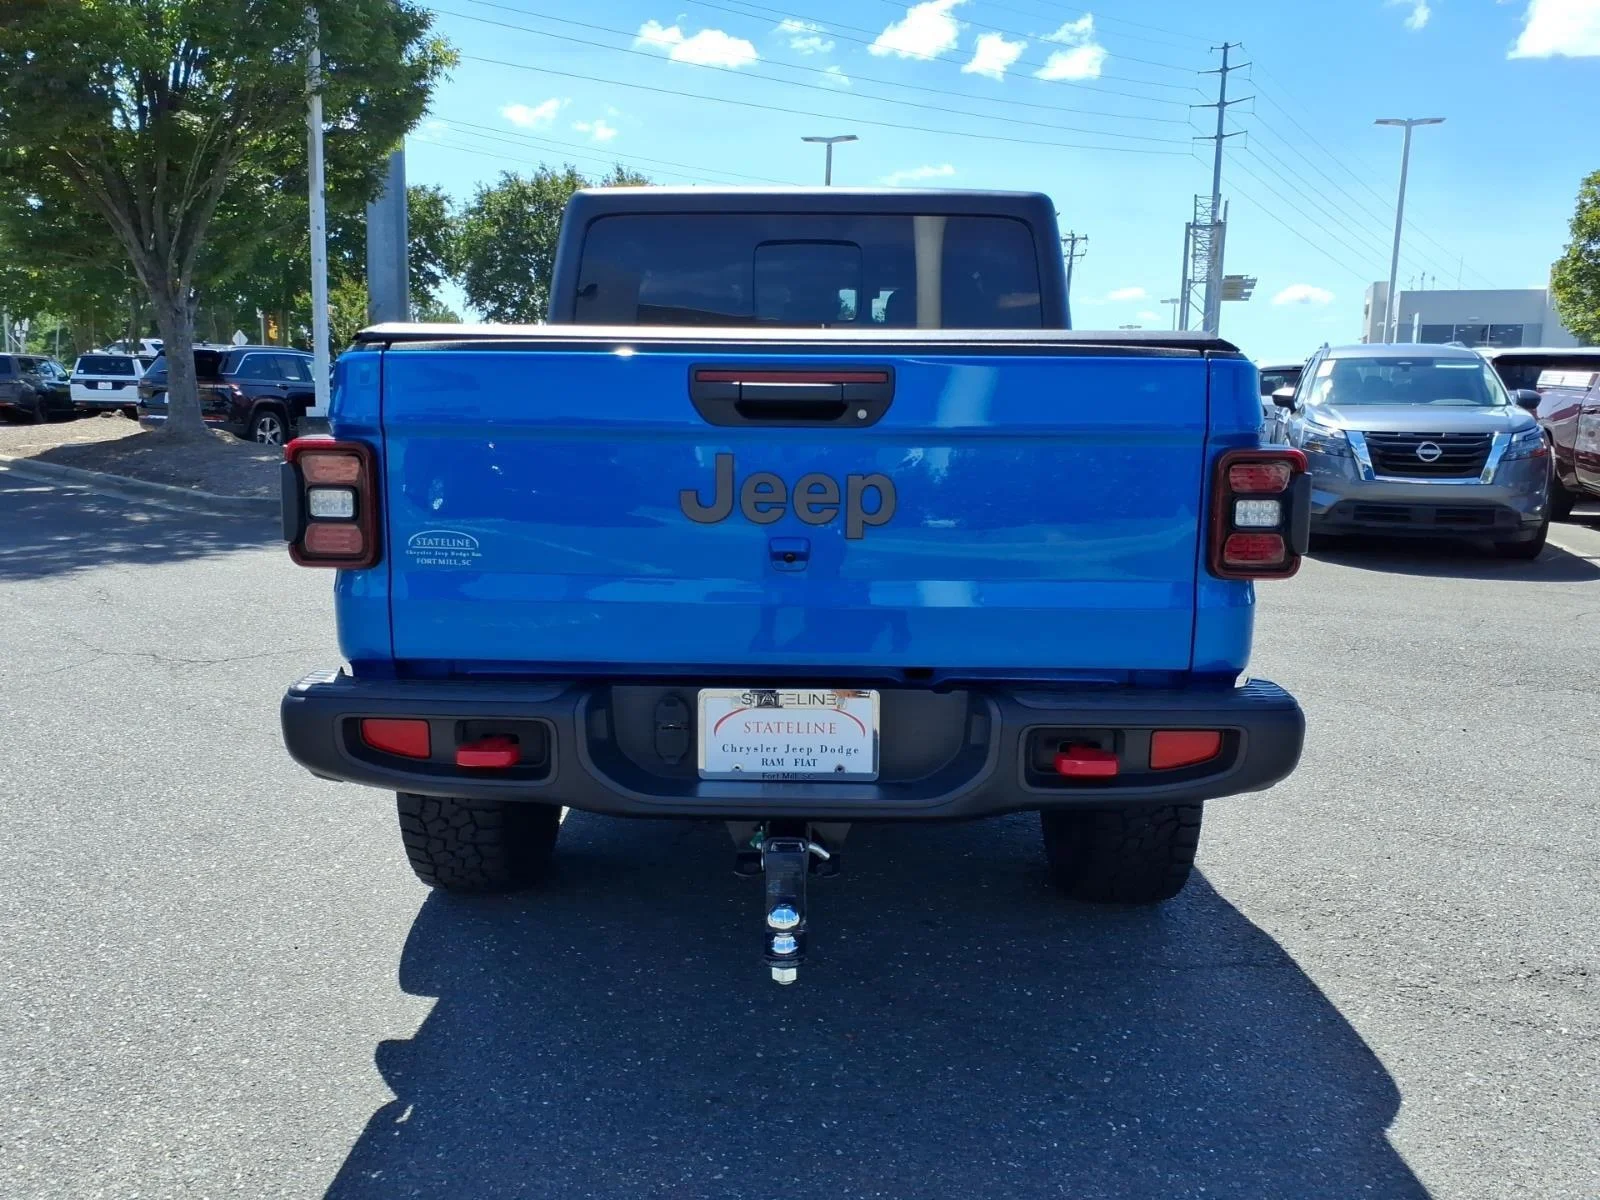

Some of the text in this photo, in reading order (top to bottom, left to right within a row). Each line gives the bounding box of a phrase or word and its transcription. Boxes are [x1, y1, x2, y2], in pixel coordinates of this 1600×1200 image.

[679, 452, 897, 540] Jeep
[416, 537, 471, 547] STATELINE
[416, 557, 437, 565] FORT
[741, 692, 838, 706] STATELINE
[743, 721, 837, 735] STATELINE
[721, 743, 860, 756] Chrysler Jeep Dodge
[761, 758, 818, 767] RAM FIAT
